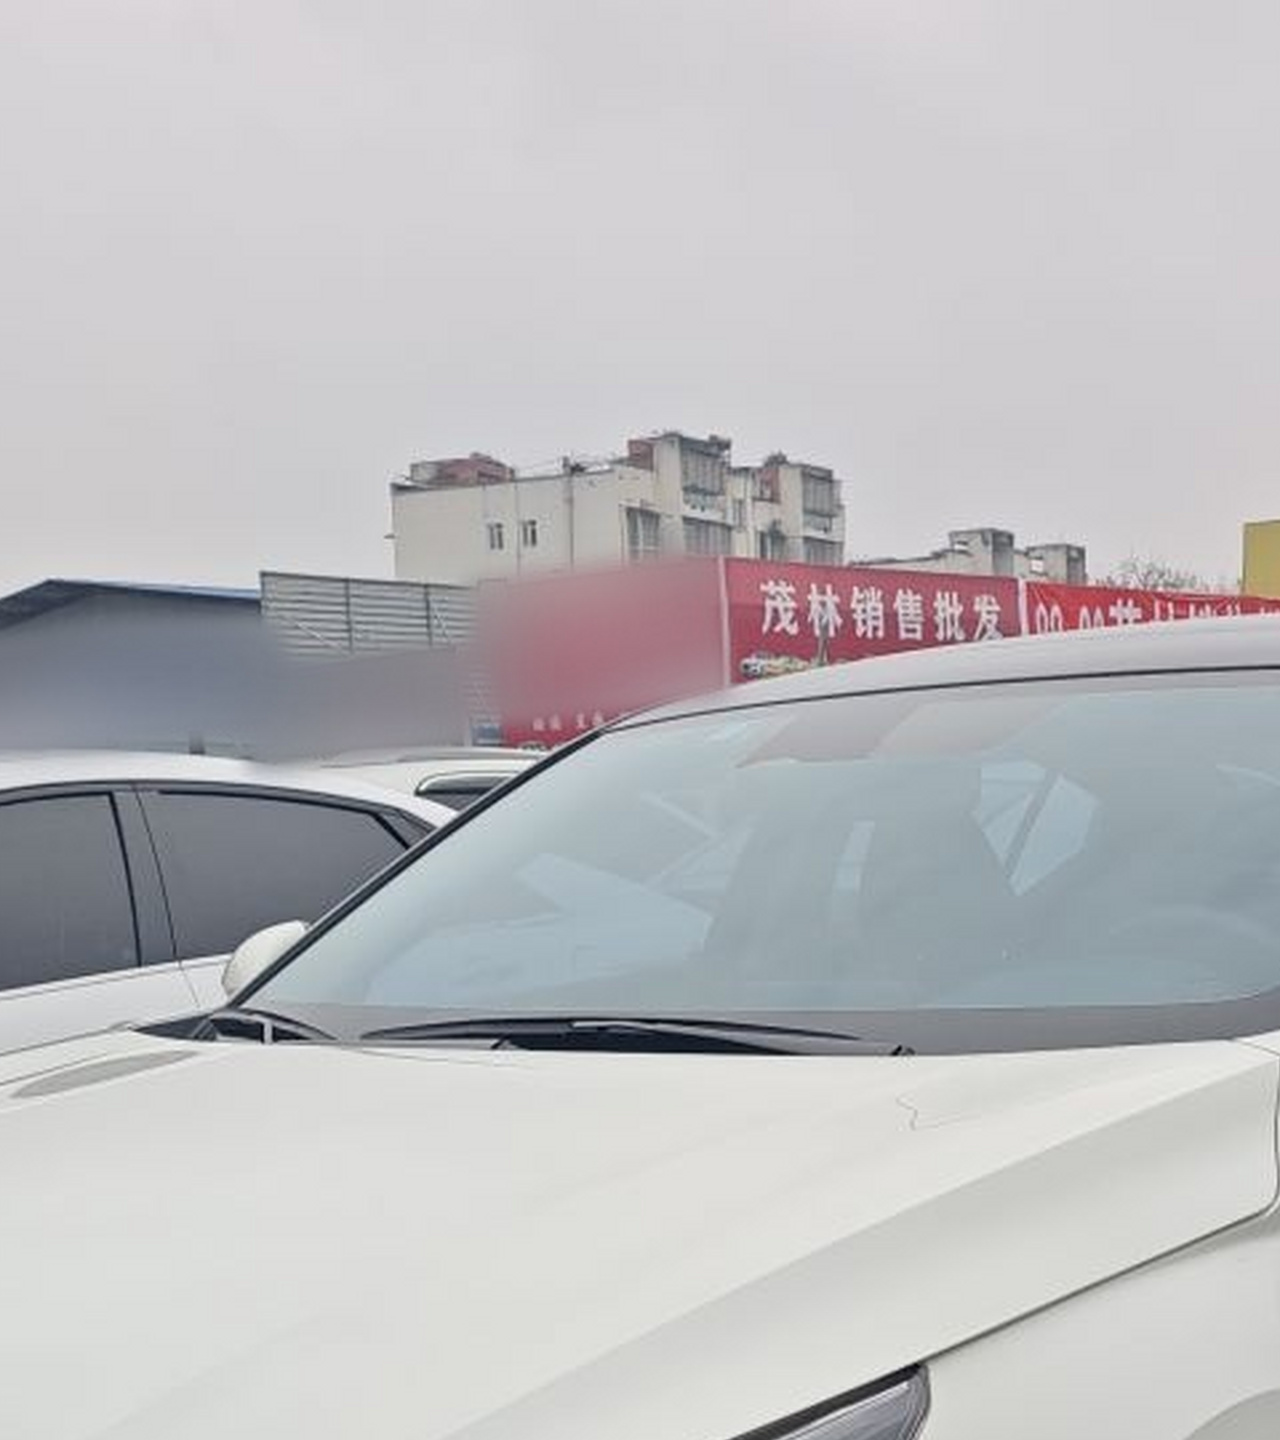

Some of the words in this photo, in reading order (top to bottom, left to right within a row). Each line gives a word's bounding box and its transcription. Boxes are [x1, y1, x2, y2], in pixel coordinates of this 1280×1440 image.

[758, 579, 1003, 642] 茂林销售批发
